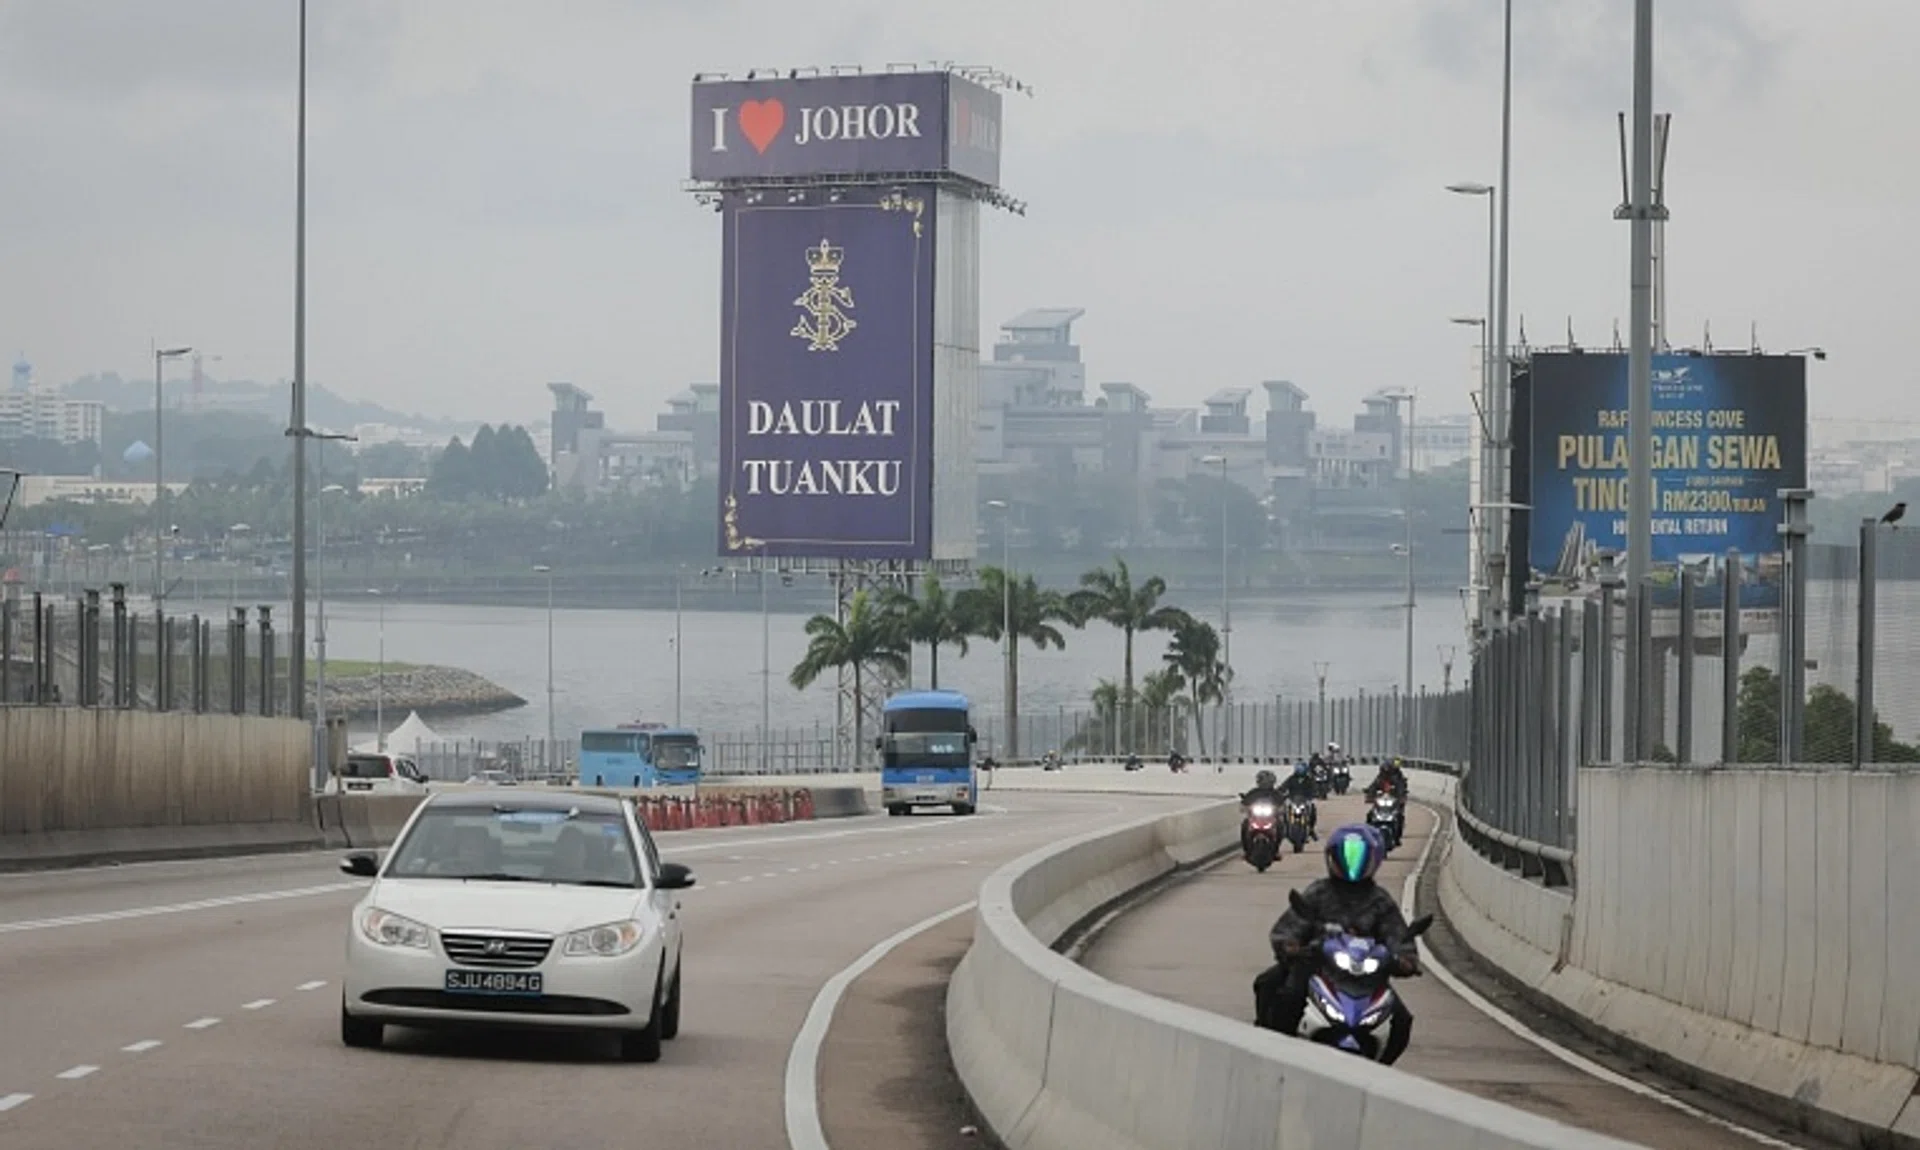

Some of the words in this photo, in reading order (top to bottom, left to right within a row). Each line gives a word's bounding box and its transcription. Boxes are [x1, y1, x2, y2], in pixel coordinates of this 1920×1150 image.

[711, 108, 728, 152] I
[795, 103, 922, 145] JOHOR
[748, 400, 900, 435] DAULAT
[1598, 410, 1629, 428] R&F
[1707, 410, 1744, 428] COVE
[1558, 435, 1698, 470] PULAGAN
[1707, 434, 1781, 470] SEWA
[742, 460, 902, 495] TUANKU
[1573, 477, 1658, 512] TINGI
[1650, 518, 1681, 535] ENTAL
